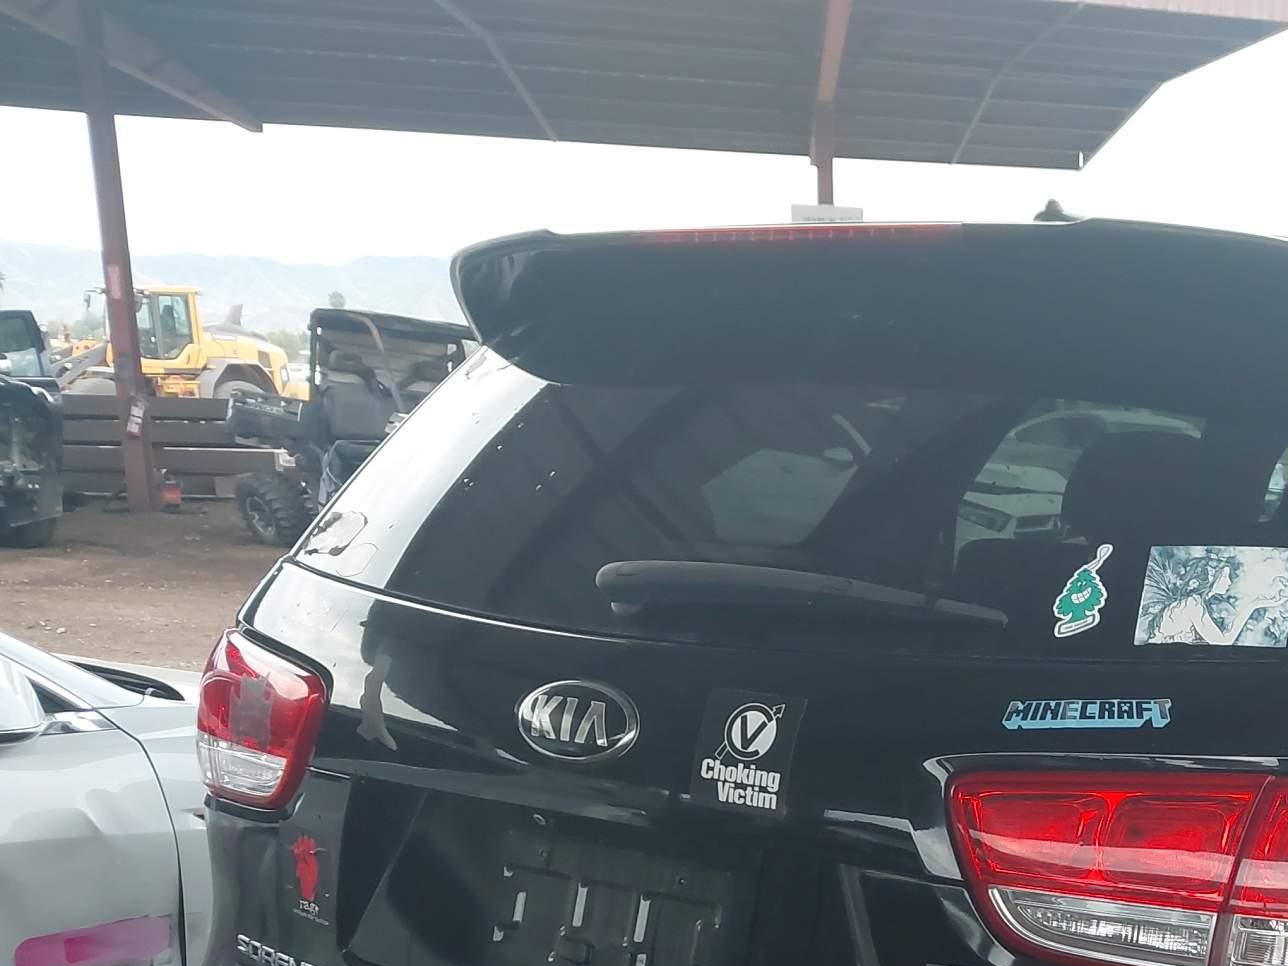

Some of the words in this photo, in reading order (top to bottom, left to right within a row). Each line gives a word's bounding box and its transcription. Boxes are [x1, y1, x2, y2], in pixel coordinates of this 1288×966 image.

[530, 694, 608, 747] KIA
[1002, 699, 1172, 730] MINECRAFT
[701, 758, 780, 793] Choking
[717, 781, 777, 810] Victim
